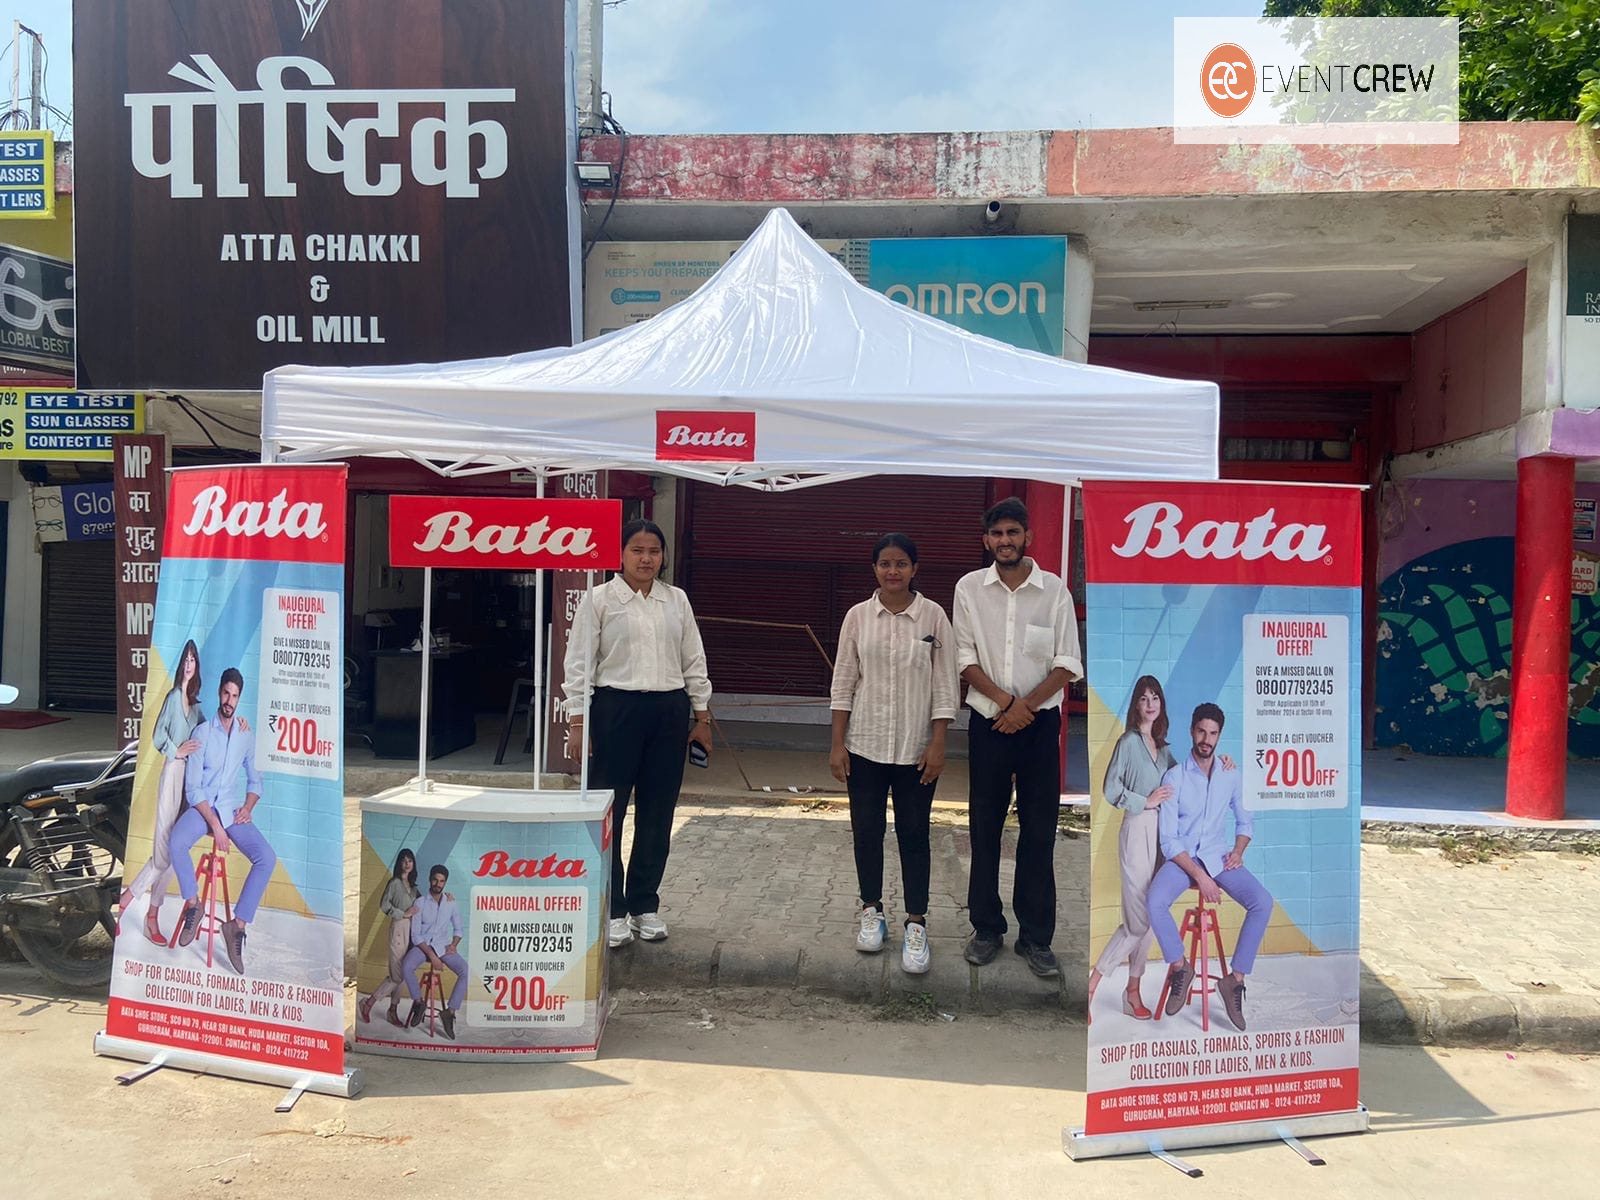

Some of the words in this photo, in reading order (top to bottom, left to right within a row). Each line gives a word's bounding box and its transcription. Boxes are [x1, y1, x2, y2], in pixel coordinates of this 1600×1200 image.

[124, 54, 516, 198] पौष्टिक
[11, 193, 42, 207] LENS
[220, 233, 296, 262] ATTA
[305, 233, 421, 262] CHAKKI
[604, 268, 639, 278] KEEPS
[641, 268, 662, 278] YOU
[309, 275, 330, 302] &
[256, 315, 303, 343] OIL
[312, 315, 386, 344] MILL
[41, 336, 71, 354] BEST
[30, 395, 69, 407] EYE
[75, 395, 127, 407] TEST
[31, 416, 60, 427] SUN
[64, 416, 129, 427] GLASSES
[29, 436, 92, 447] CONTECT
[663, 425, 748, 447] Bata
[123, 445, 152, 478] MP
[73, 490, 116, 515] Glo
[128, 491, 151, 512] का
[182, 485, 328, 540] Bata
[413, 511, 598, 555] Bata
[1111, 501, 1332, 562] Bata
[278, 595, 326, 614] INAUGURAL
[126, 602, 154, 635] MP
[286, 613, 317, 630] OFFER!
[1262, 621, 1328, 638] INAUGURAL
[289, 638, 310, 649] MISSED
[311, 640, 323, 650] CALL
[1277, 639, 1314, 656] OFFER!
[273, 649, 331, 669] 08007792345
[1255, 666, 1272, 676] GIVE
[1274, 666, 1279, 676] A
[1281, 666, 1305, 676] MISSED
[1306, 666, 1322, 676] CALL
[1323, 666, 1334, 676] ON
[1256, 679, 1334, 695] 08007792345
[1256, 733, 1268, 744] AND
[1270, 733, 1282, 744] GET
[1284, 733, 1289, 743] A
[1291, 733, 1304, 744] GIFT
[1305, 733, 1334, 743] VOUCHER
[472, 850, 588, 878] Bata
[476, 895, 541, 911] INAUGURAL
[544, 896, 582, 911] OFFER!
[483, 922, 501, 934] GIVE
[503, 922, 508, 934] A
[510, 922, 540, 934] MISSED
[542, 922, 560, 934] CALL
[562, 922, 574, 934] ON
[483, 936, 573, 953] 08007792345
[484, 961, 499, 971] AND
[500, 961, 512, 971] GET
[513, 961, 518, 971] A
[520, 961, 534, 971] GIFT
[535, 961, 565, 971] VOUCHER
[124, 960, 144, 977] SHOP
[145, 964, 161, 979] FOR
[164, 967, 204, 989] CASUALS,
[206, 974, 248, 995] FORMALS,
[252, 980, 285, 999] SPORTS
[287, 985, 294, 1000] &
[296, 987, 334, 1007] FASHION
[145, 983, 193, 1004] COLLECTION
[196, 991, 212, 1007] FOR
[214, 995, 247, 1015] LADIES,
[250, 999, 270, 1017] MEN
[272, 1003, 279, 1018] &
[282, 1004, 305, 1023] KIDS.
[513, 1014, 532, 1022] Invoice
[533, 1014, 549, 1022] Value
[1101, 1045, 1127, 1064] SHOP
[1130, 1042, 1148, 1059] FOR
[1152, 1039, 1201, 1057] CASUALS,
[1203, 1035, 1252, 1054] FORMALS,
[1255, 1031, 1292, 1050] SPORTS
[1294, 1030, 1302, 1047] &
[1304, 1027, 1345, 1046] FASHION
[1130, 1061, 1189, 1081] COLLECTION
[1193, 1059, 1212, 1077] FOR
[1215, 1056, 1252, 1075] LADIES,
[1255, 1054, 1276, 1071] MEN
[1279, 1053, 1287, 1069] &
[1290, 1050, 1315, 1068] KIDS.
[1101, 1097, 1118, 1110] BATA
[1118, 1095, 1137, 1108] SHOE
[1201, 1088, 1220, 1100] NEAR
[1220, 1087, 1232, 1098] SBI
[1303, 1078, 1328, 1091] SECTOR
[1229, 1100, 1260, 1112] CONTACT
[1260, 1098, 1270, 1109] NO
